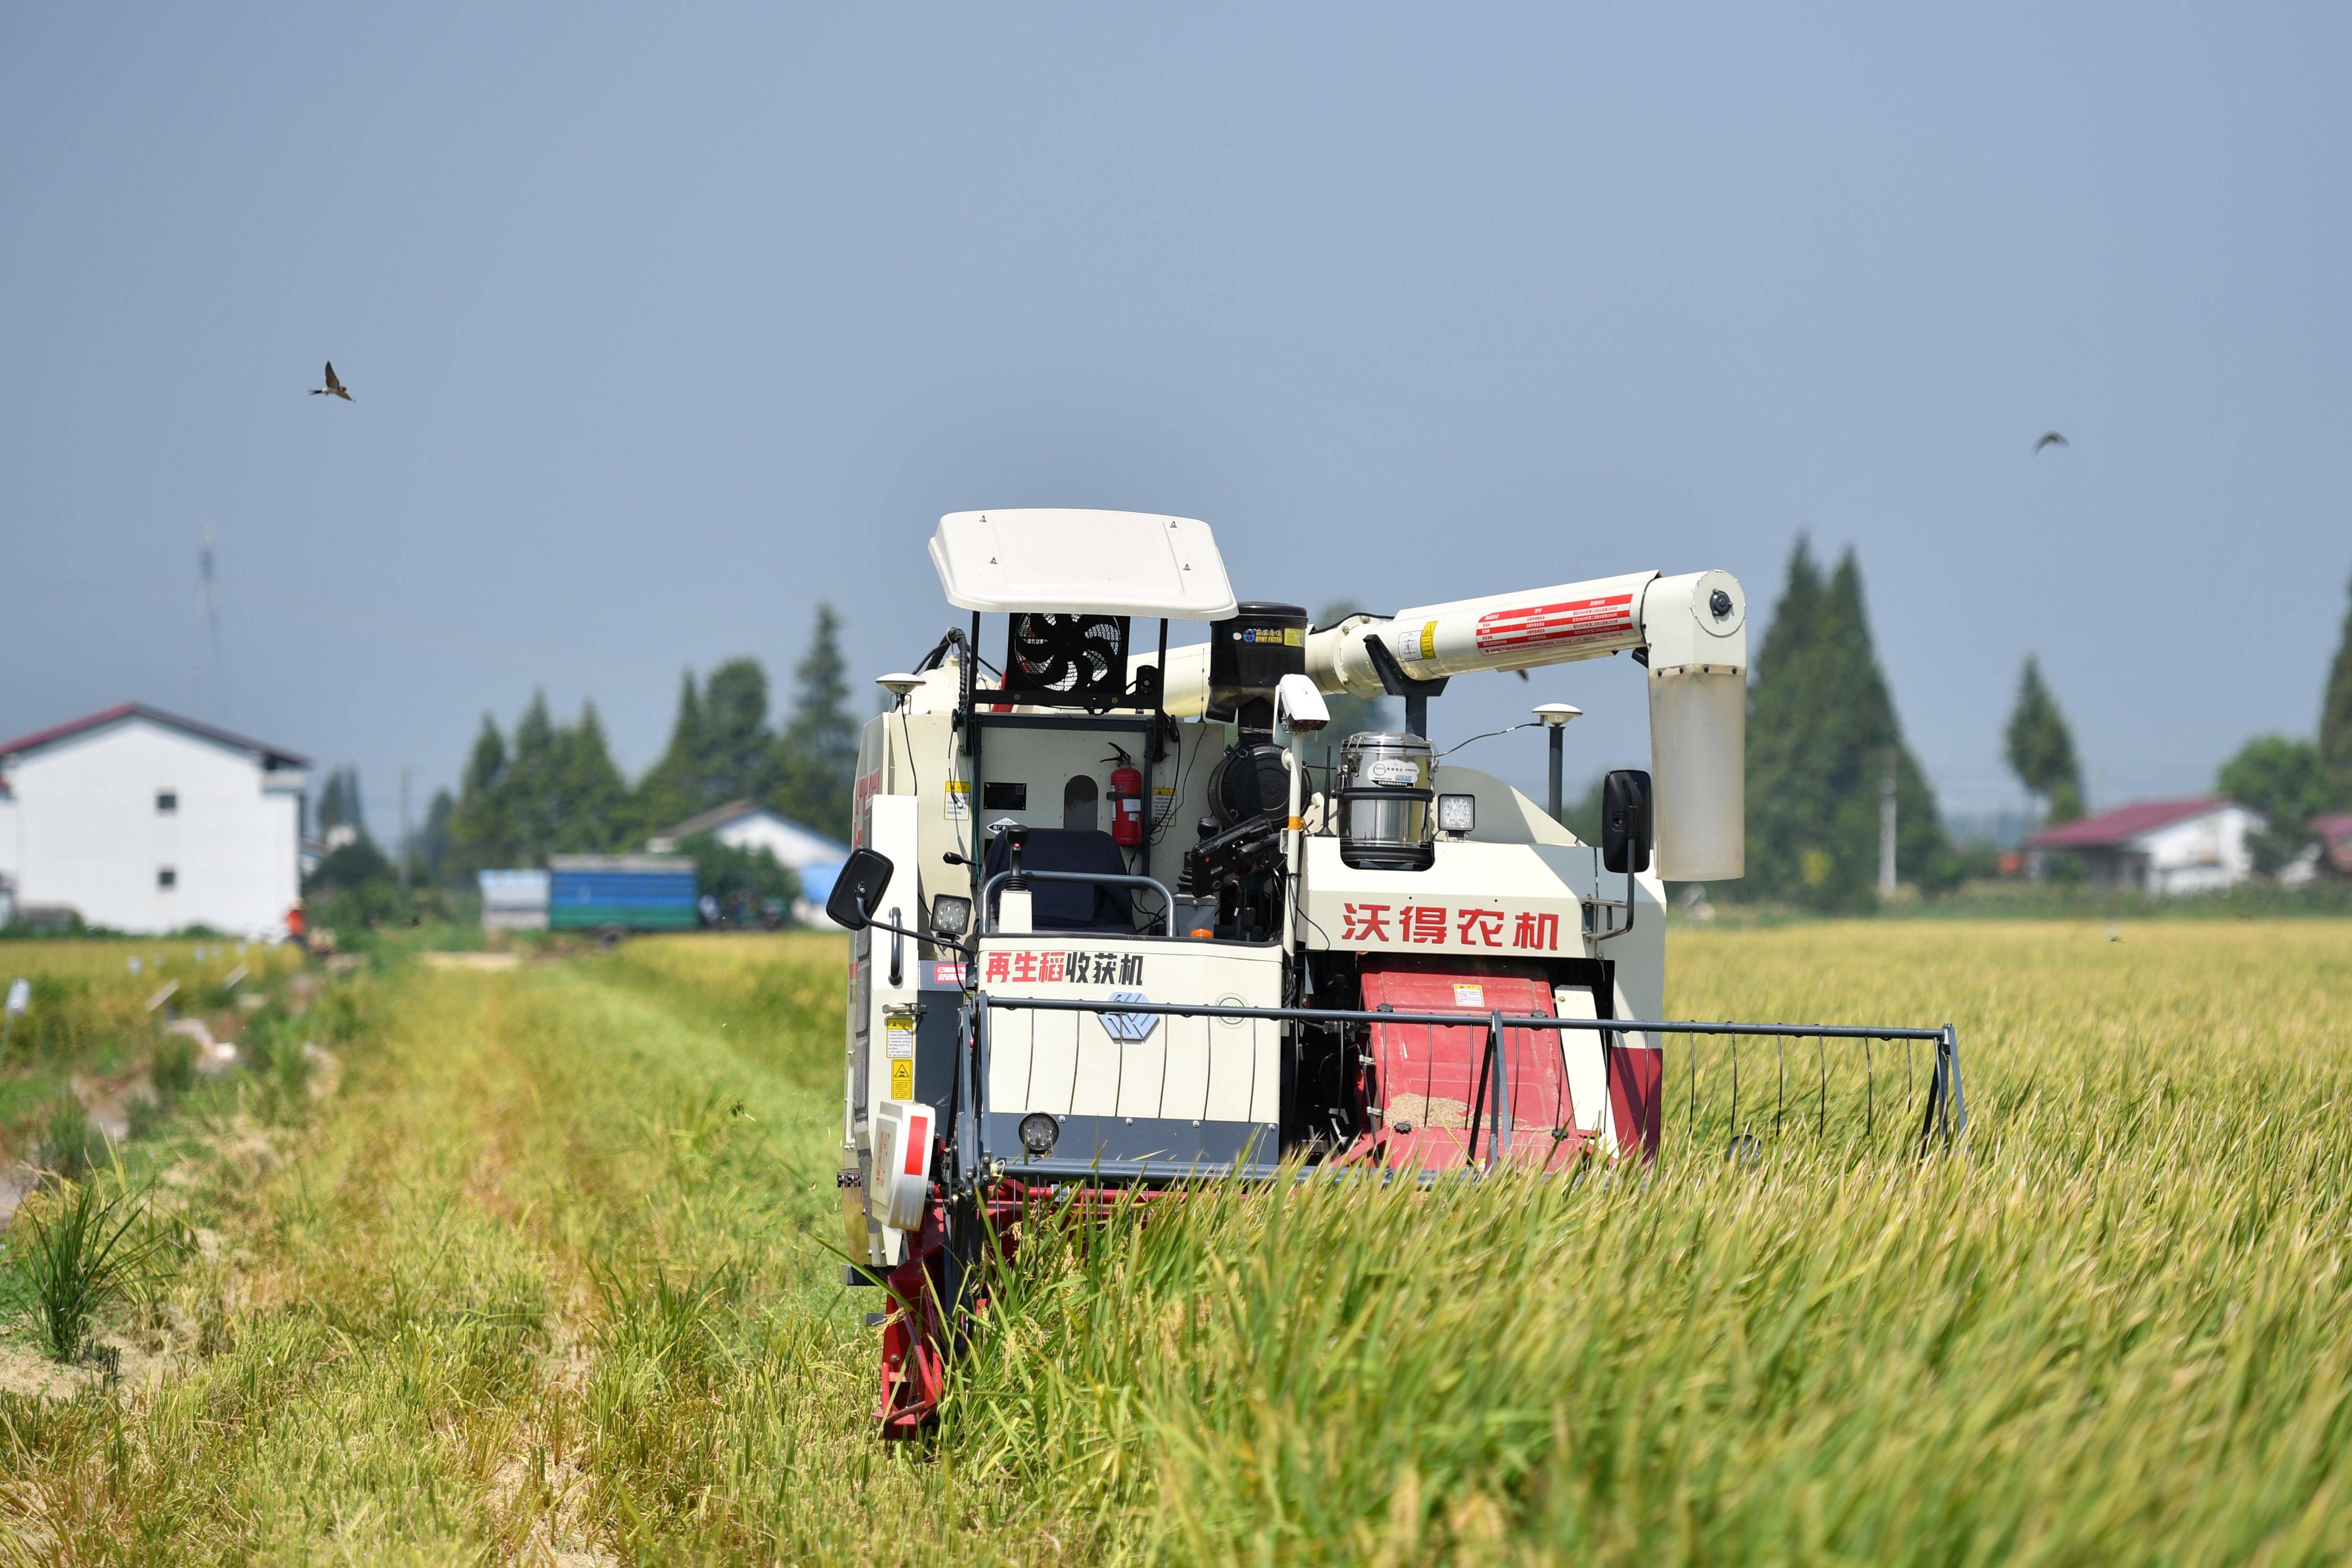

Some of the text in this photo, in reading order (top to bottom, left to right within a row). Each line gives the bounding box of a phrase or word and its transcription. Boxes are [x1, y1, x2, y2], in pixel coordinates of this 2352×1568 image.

[1341, 903, 1559, 951] 沃得农机
[986, 951, 1144, 986] 再生稻收获机
